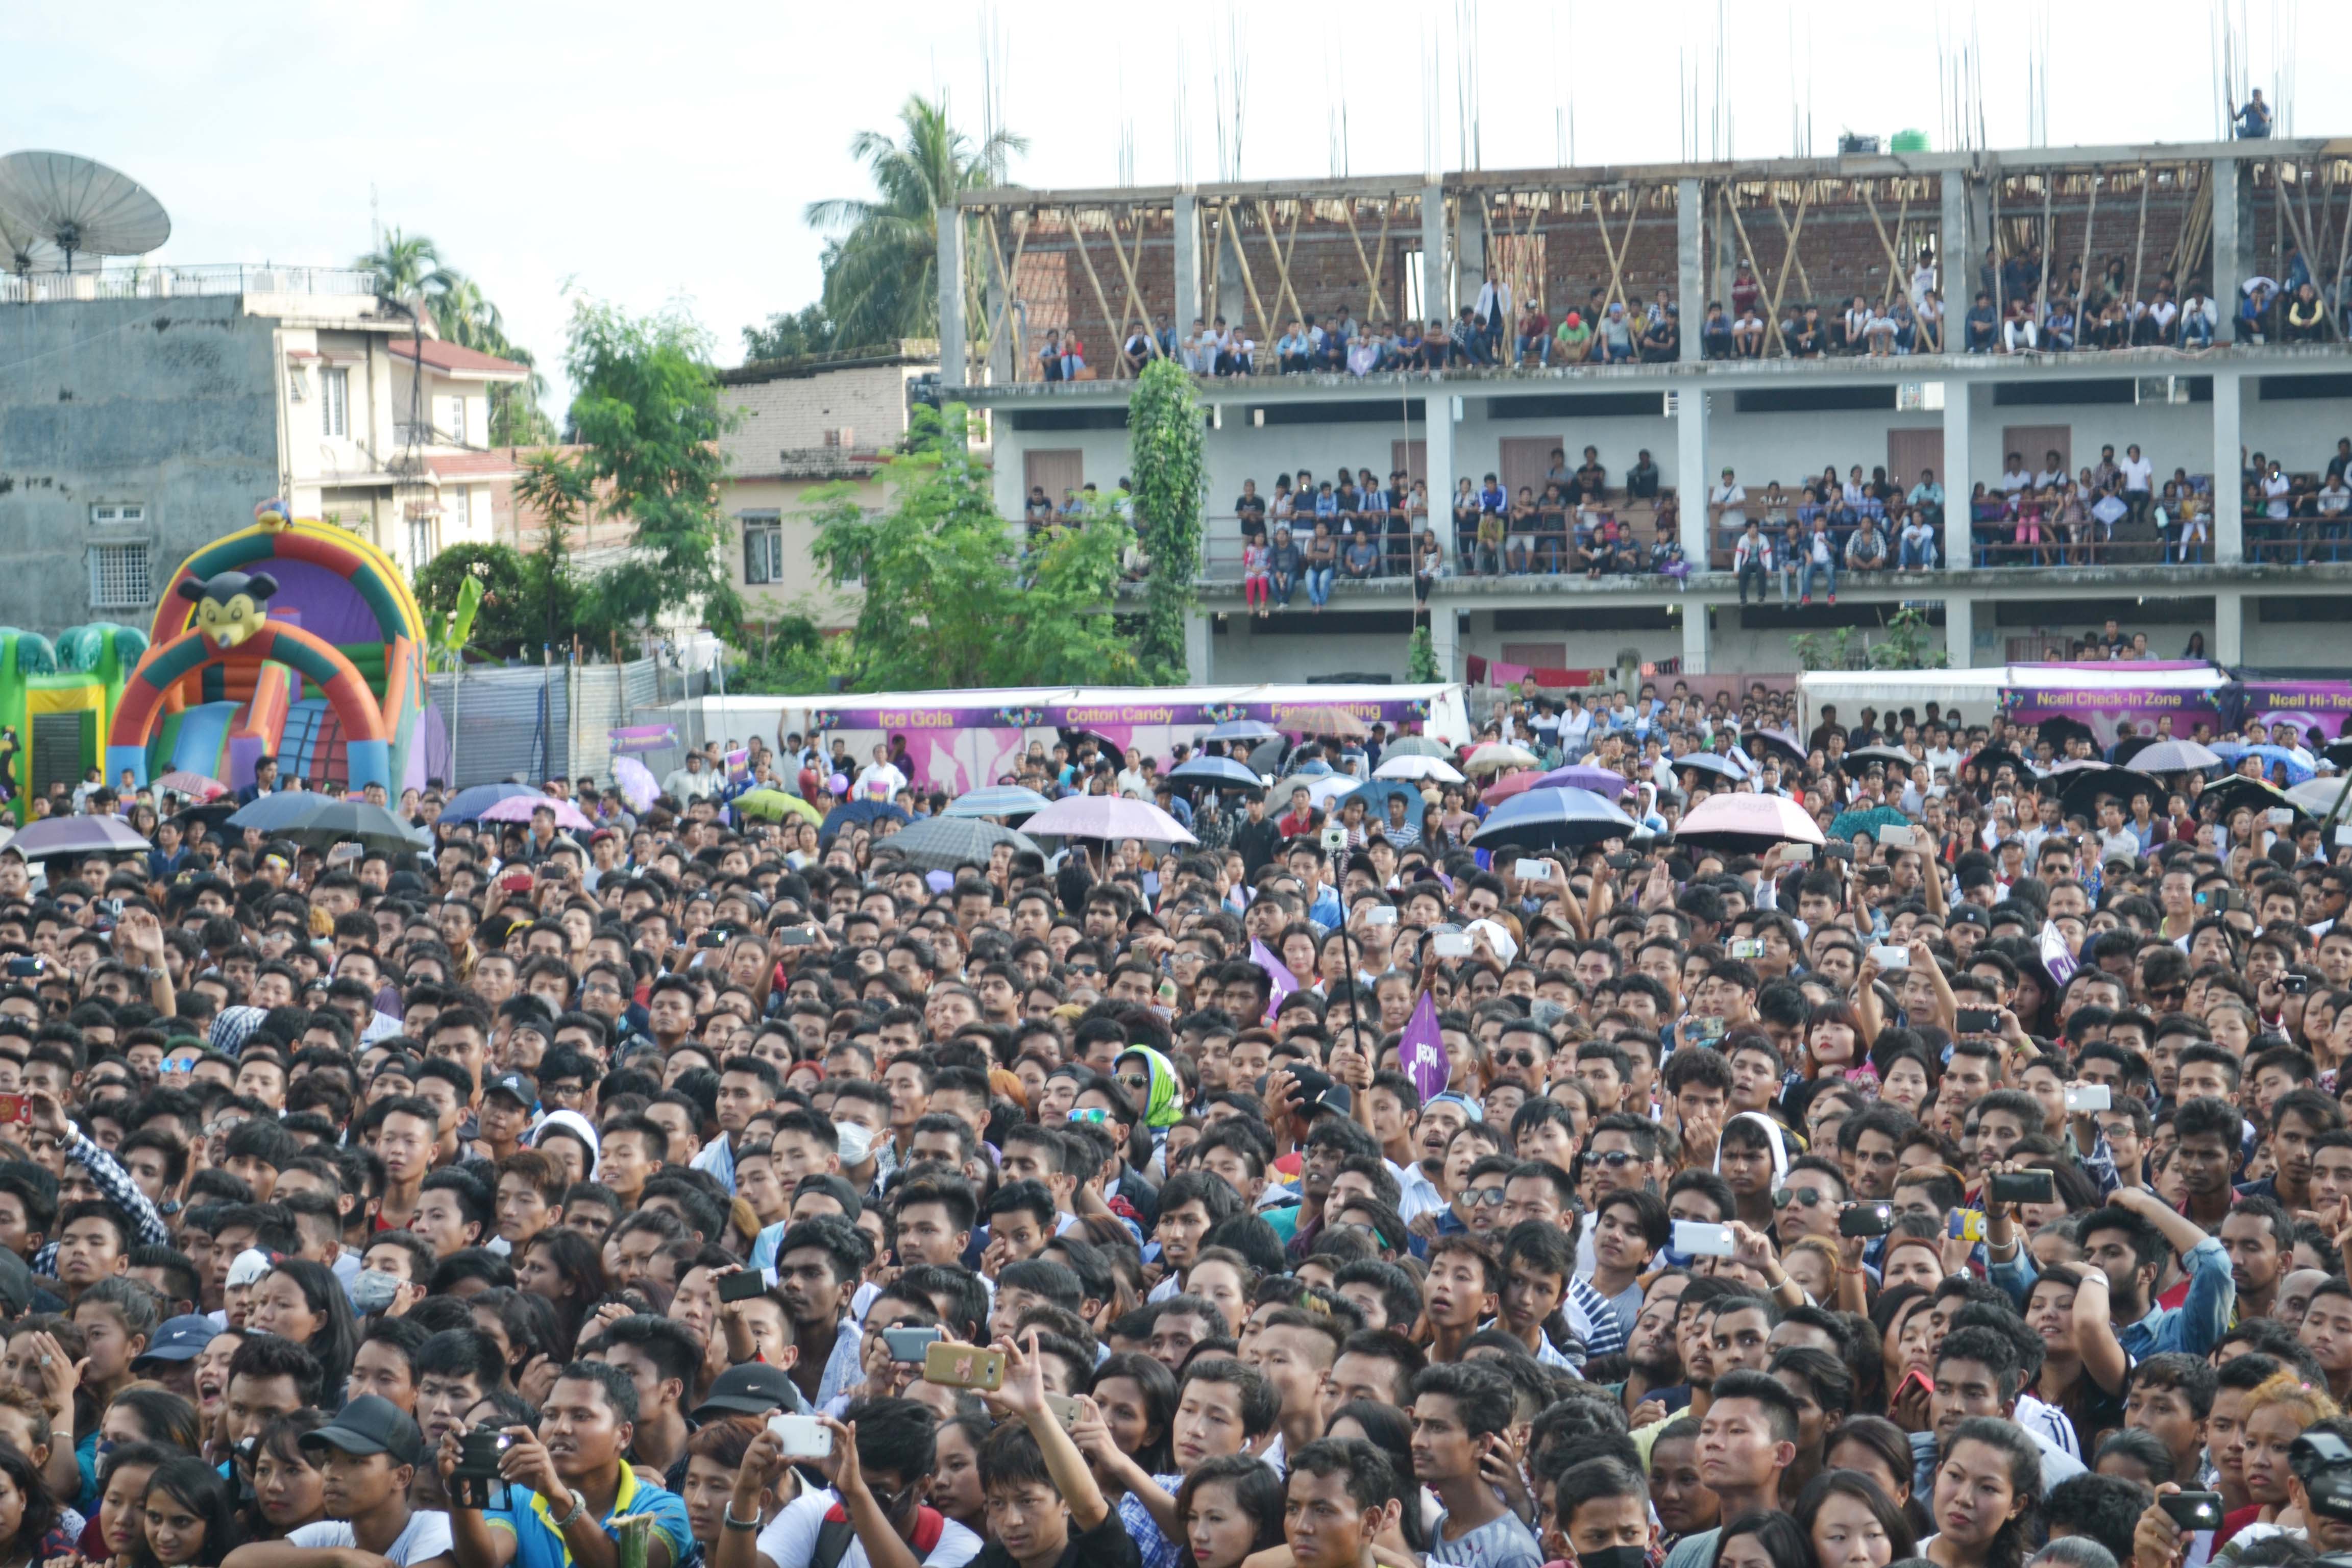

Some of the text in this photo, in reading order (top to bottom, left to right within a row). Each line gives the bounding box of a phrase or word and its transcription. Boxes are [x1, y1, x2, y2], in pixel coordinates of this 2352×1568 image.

[2037, 691, 2182, 707] Ncell Check-In Zone
[2269, 693, 2305, 708] Ncell
[879, 709, 953, 728] Ice Gola
[1066, 706, 1173, 725] Cotton Candy
